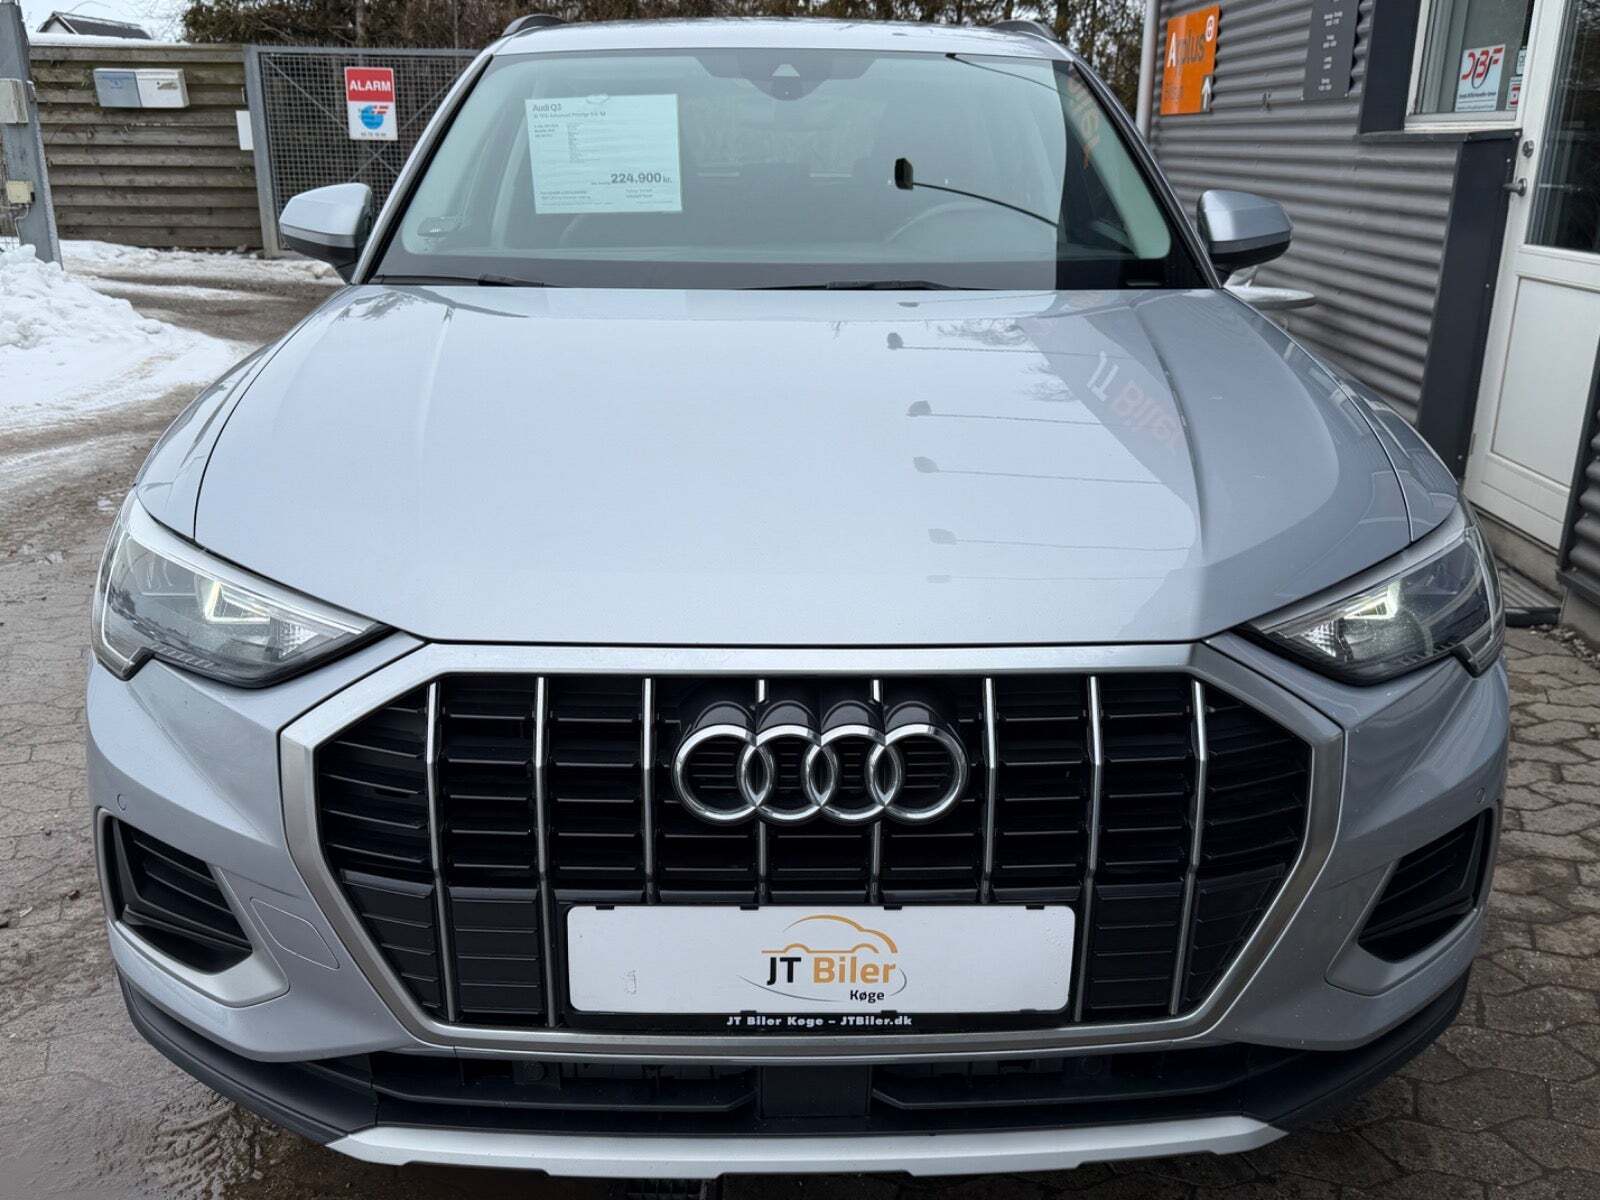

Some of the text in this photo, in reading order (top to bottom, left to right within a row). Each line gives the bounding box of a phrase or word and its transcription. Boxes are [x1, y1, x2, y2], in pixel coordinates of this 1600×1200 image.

[350, 80, 391, 92] ALARM
[532, 103, 562, 112] Audi Q3
[610, 172, 662, 185] 224.900
[766, 956, 896, 985] JT Biler
[849, 989, 885, 1003] Køge
[726, 1016, 742, 1026] JT
[746, 1015, 782, 1026] Biler
[839, 1015, 913, 1026] JTBiler.dk
